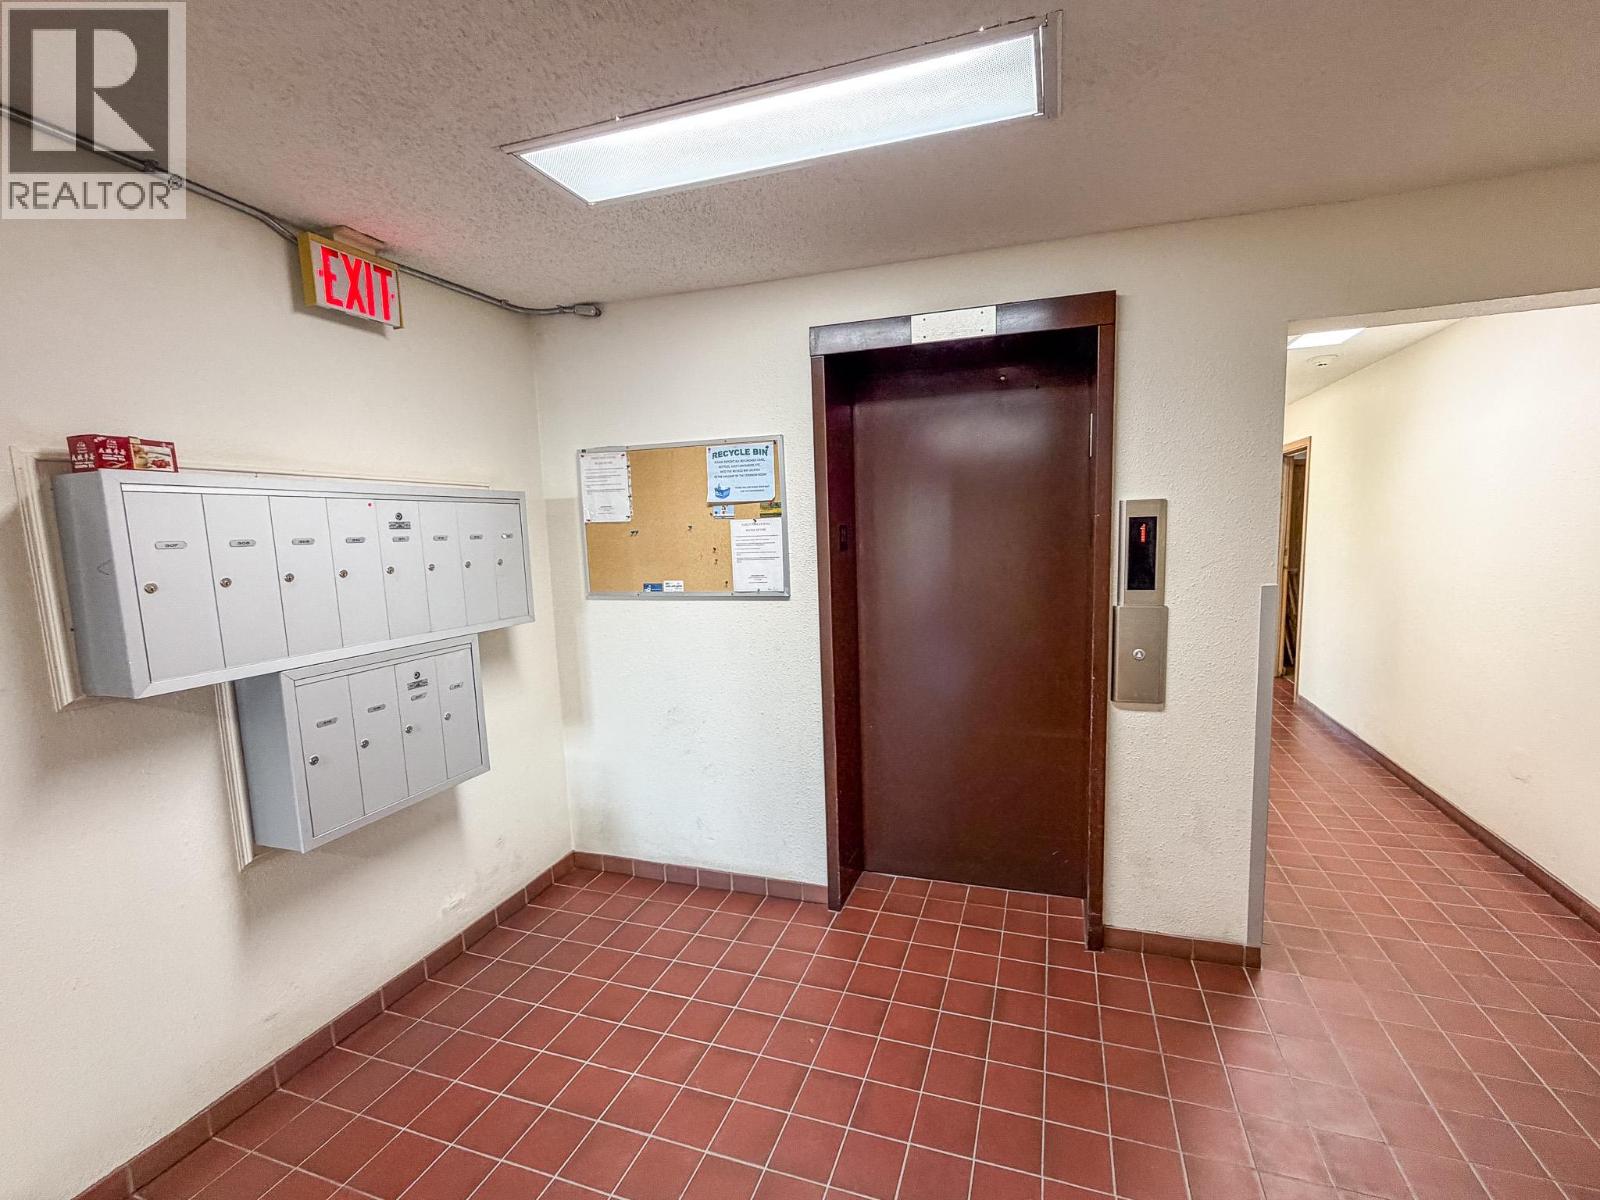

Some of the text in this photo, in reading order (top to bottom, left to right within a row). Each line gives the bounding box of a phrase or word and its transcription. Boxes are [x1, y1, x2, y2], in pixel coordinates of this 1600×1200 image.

[320, 245, 393, 321] EXIT
[712, 448, 768, 459] RECYCLE BIN
[1140, 523, 1146, 543] 1
